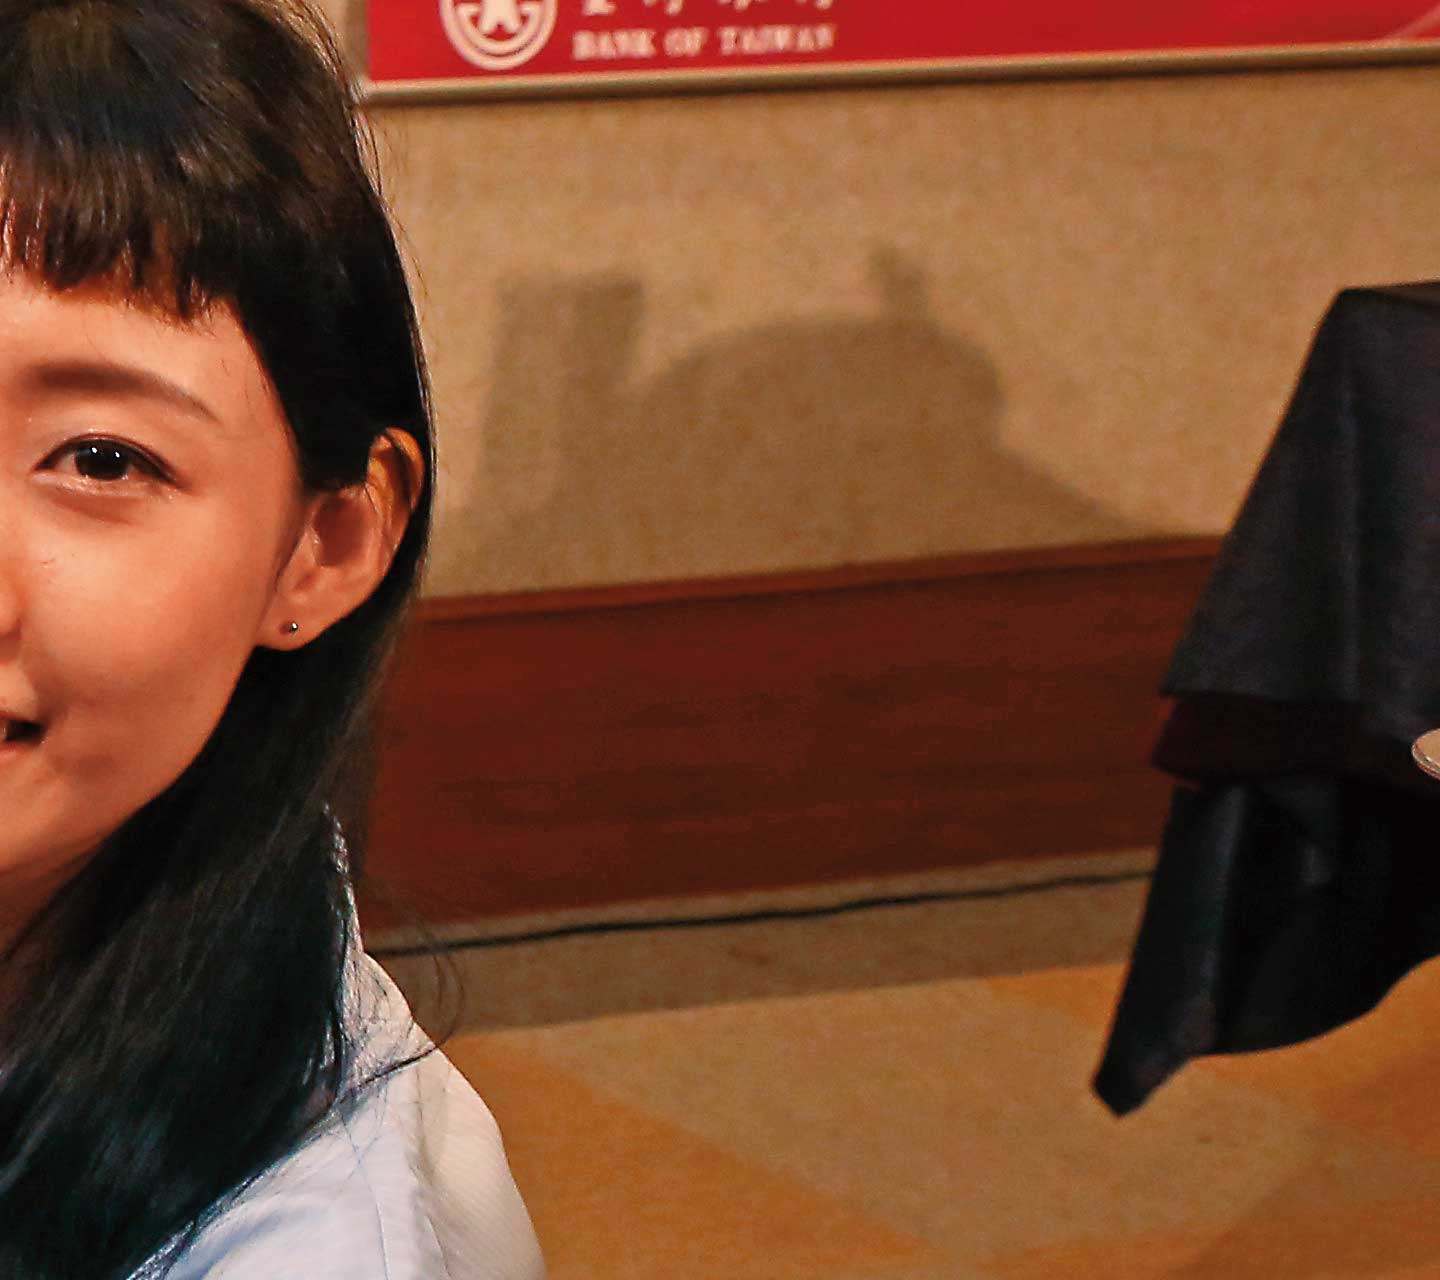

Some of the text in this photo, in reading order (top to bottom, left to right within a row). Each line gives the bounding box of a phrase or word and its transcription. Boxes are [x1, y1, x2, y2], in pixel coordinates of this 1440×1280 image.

[572, 24, 837, 60] BANK OF TAIWAN
